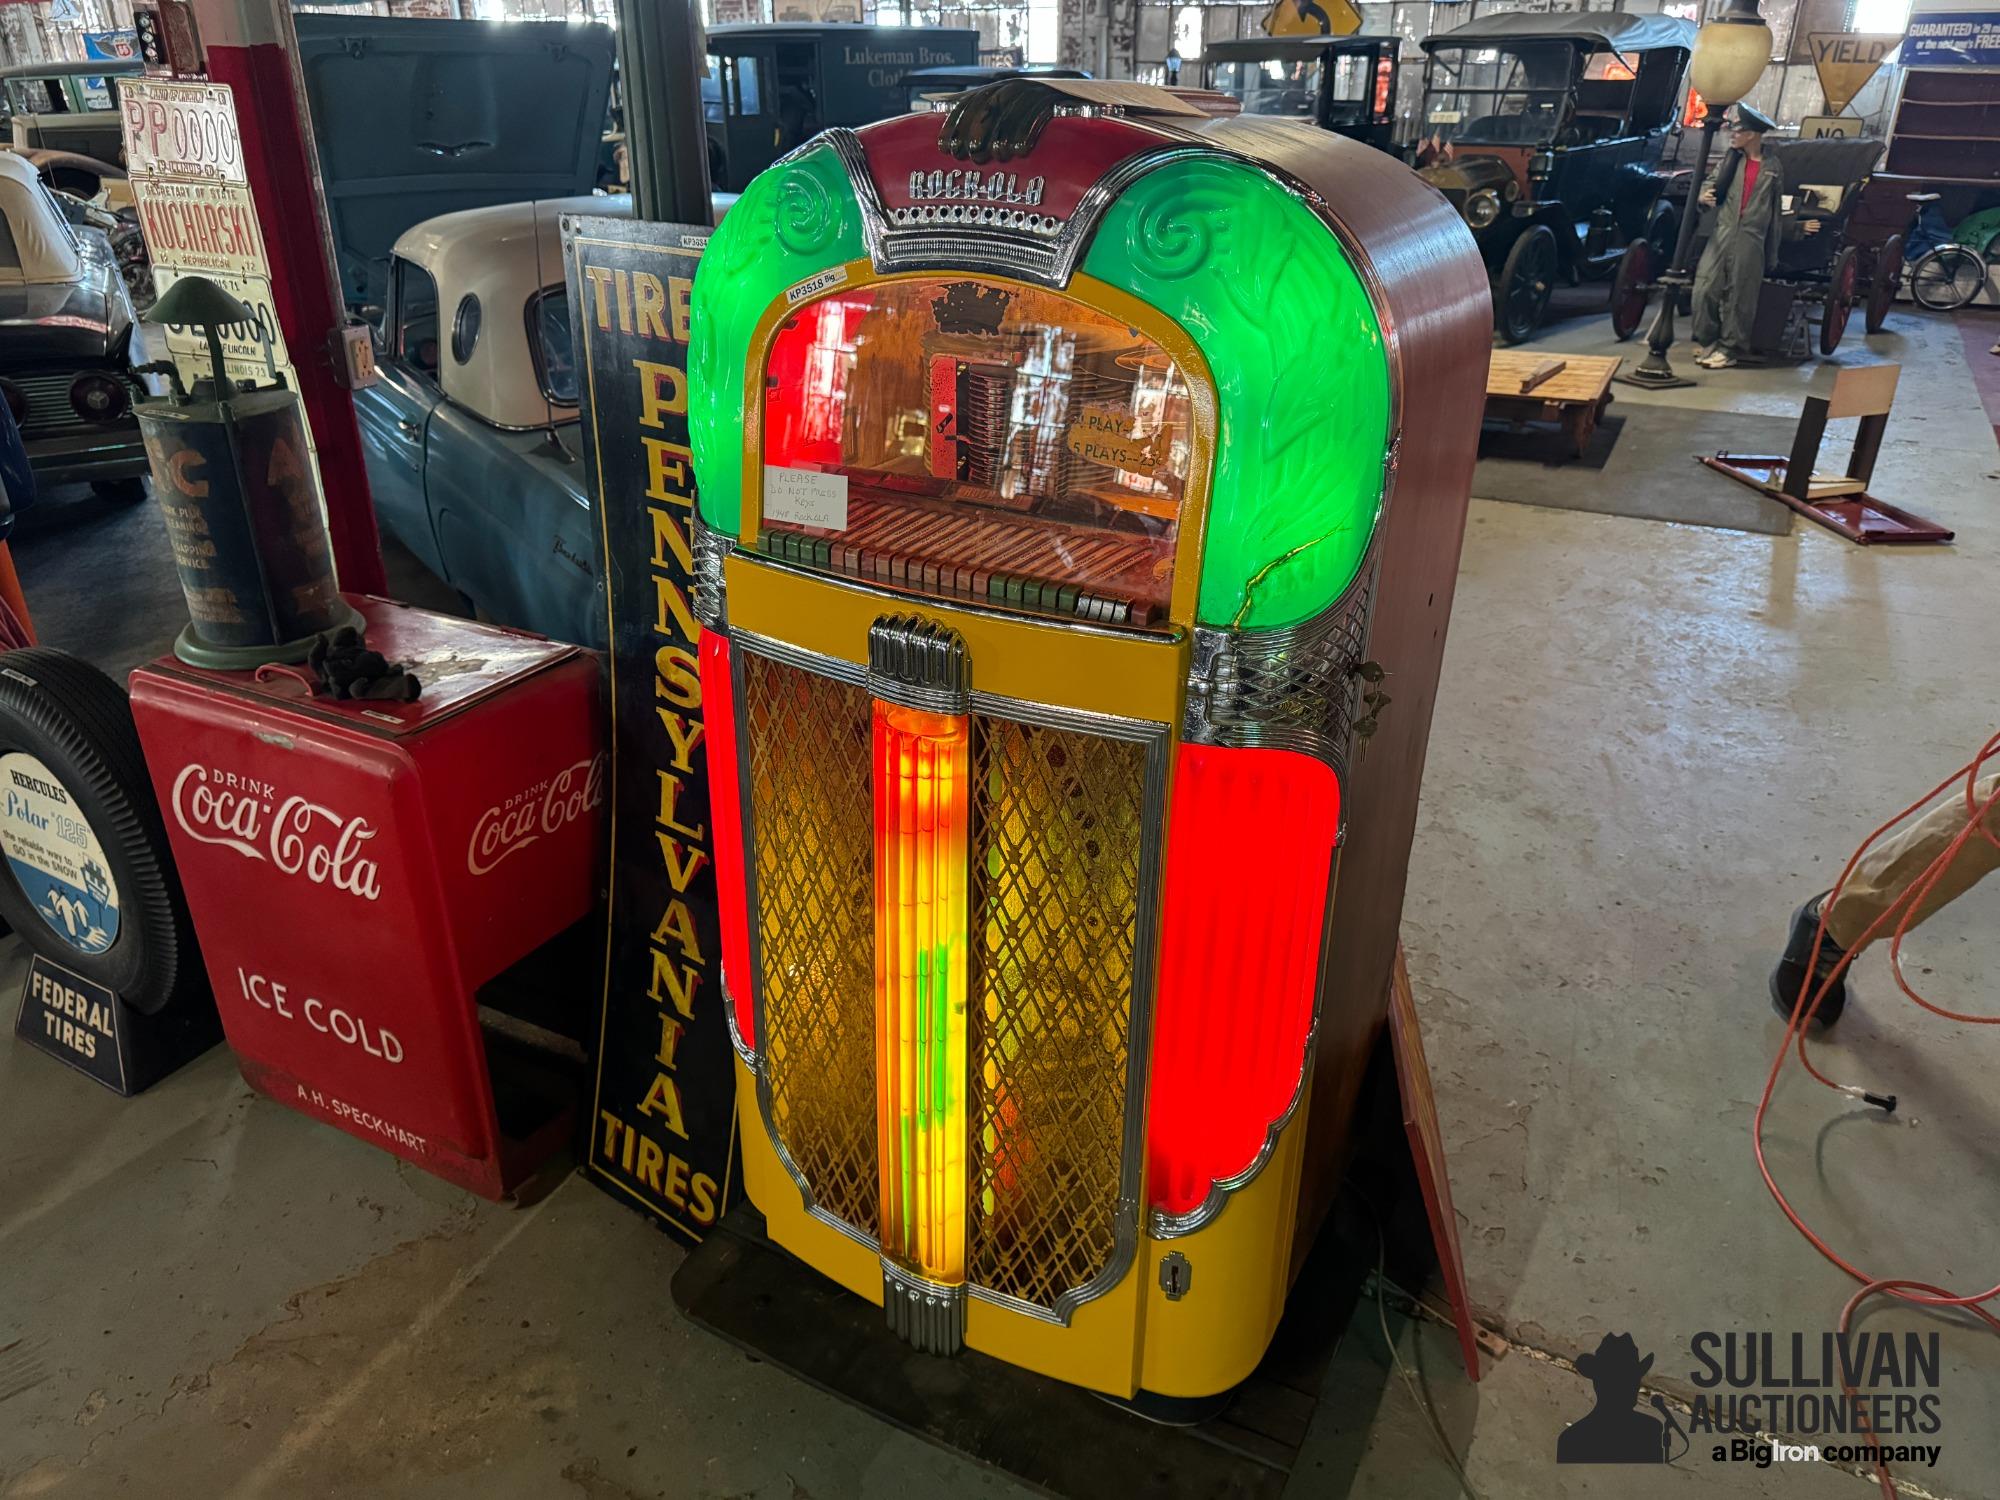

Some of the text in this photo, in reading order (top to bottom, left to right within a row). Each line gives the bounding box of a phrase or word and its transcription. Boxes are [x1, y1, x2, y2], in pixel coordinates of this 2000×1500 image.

[1817, 40, 1885, 64] YIELD
[1909, 23, 1973, 37] GUARANTEED
[844, 46, 955, 64] Lukeman Bros.
[143, 201, 256, 256] KUCHARSKI
[789, 279, 823, 300] KP3518
[10, 769, 68, 805] HERCULES
[213, 768, 276, 801] DRINK
[504, 779, 550, 811] DRINK
[1, 787, 49, 832] Polar
[172, 764, 382, 901] Coca-Cola
[31, 970, 114, 1039] FEDERAL
[238, 967, 405, 1064] ICE COLD
[43, 1009, 97, 1059] TIRES
[331, 1099, 427, 1154] SPECKHART
[600, 1109, 719, 1227] TIRES
